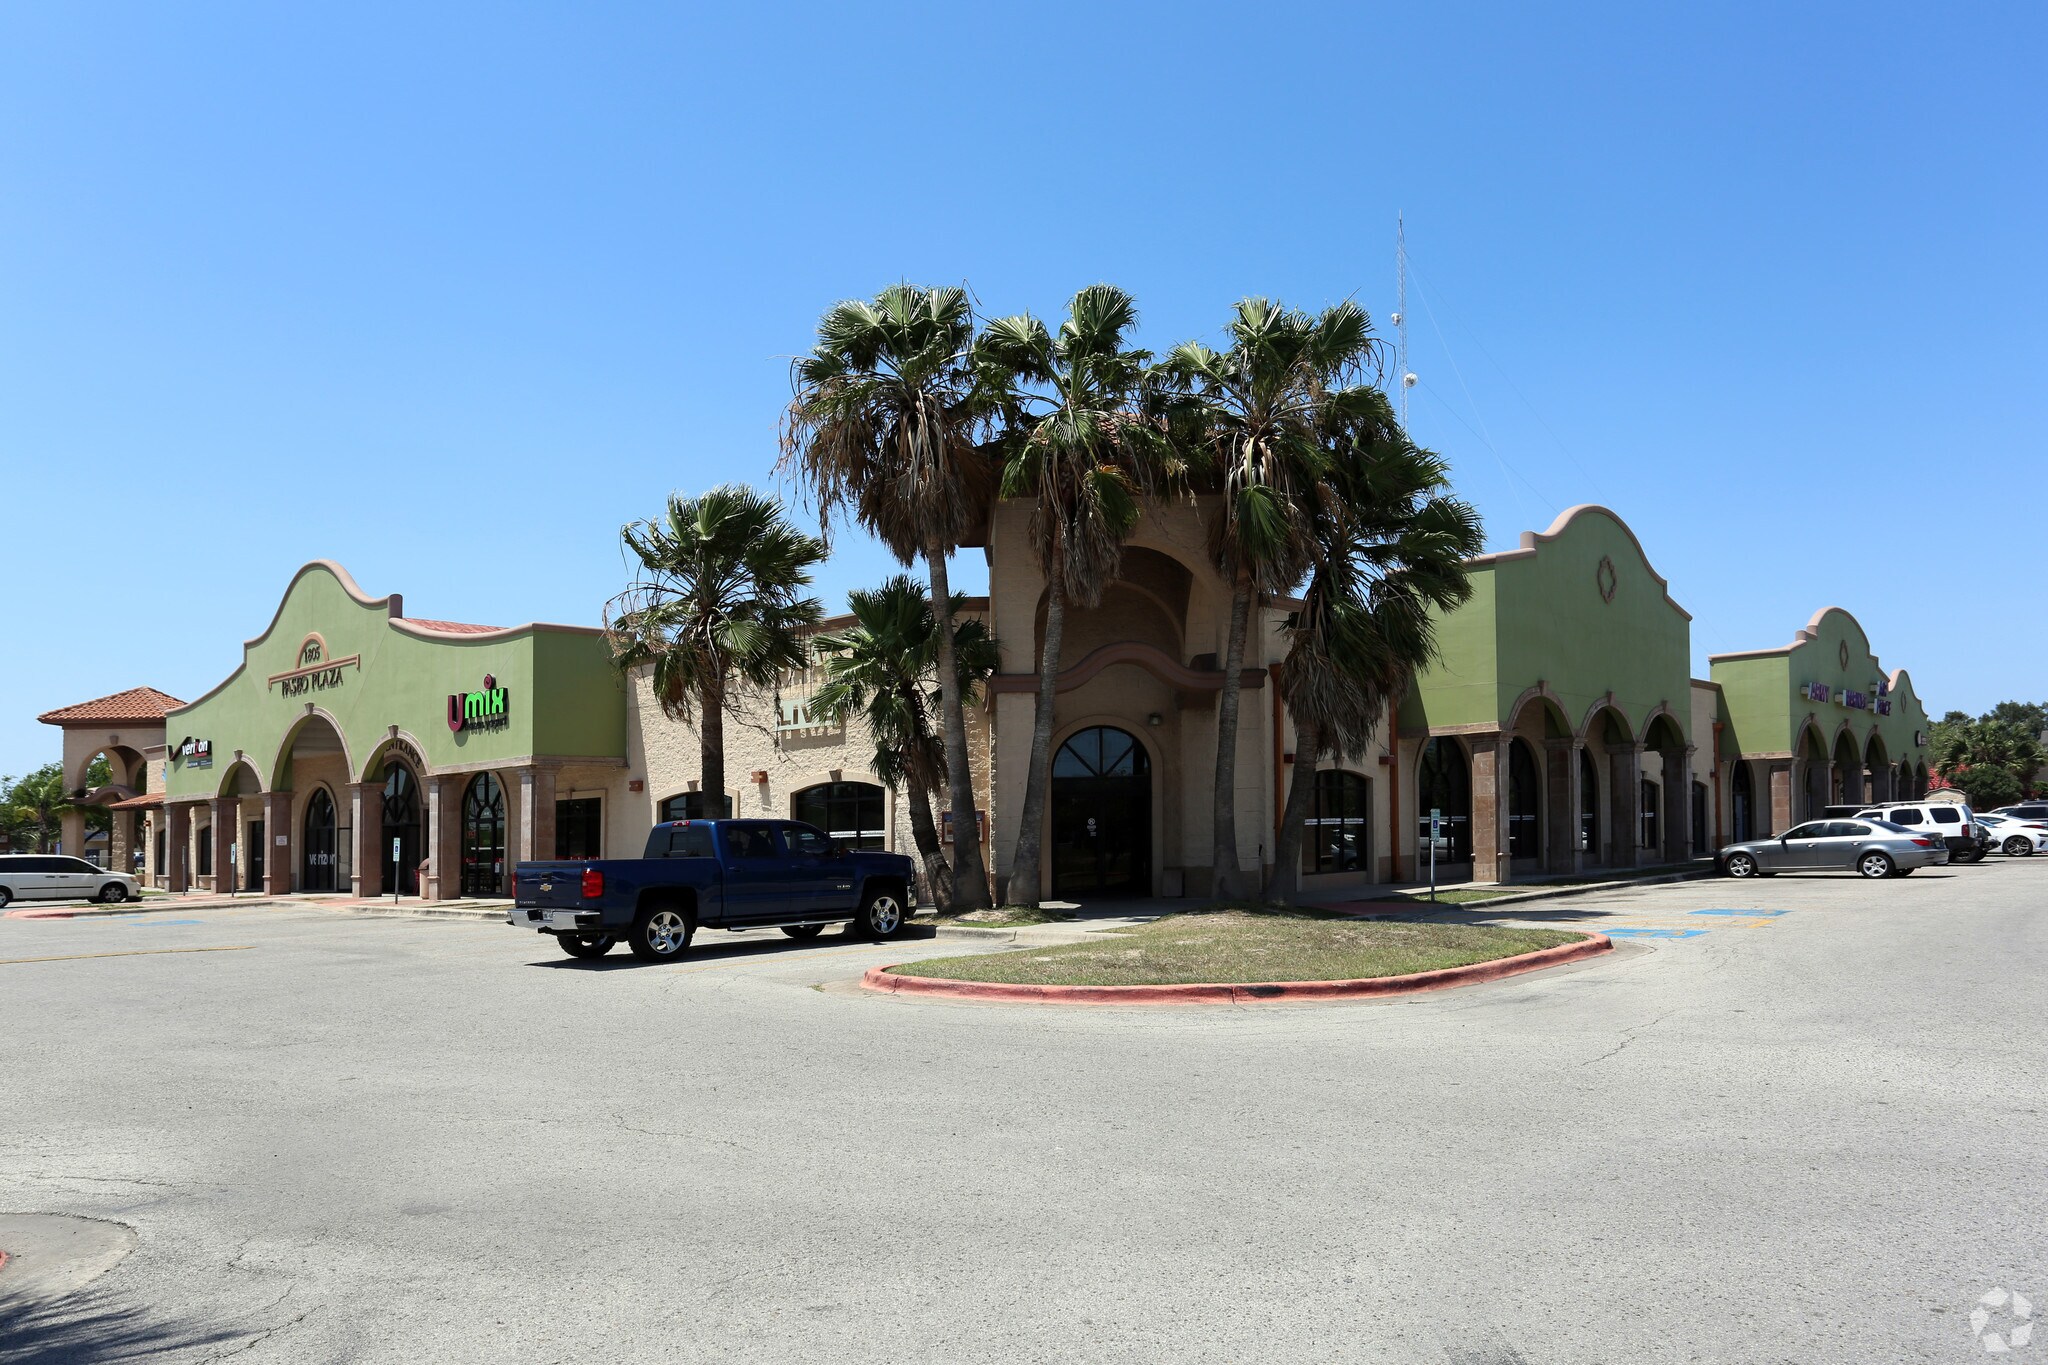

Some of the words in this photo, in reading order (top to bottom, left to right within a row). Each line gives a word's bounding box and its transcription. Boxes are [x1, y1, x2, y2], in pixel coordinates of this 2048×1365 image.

[304, 646, 320, 663] 1805
[282, 675, 308, 697] PASEO
[312, 667, 343, 690] PLAZA
[182, 739, 208, 757] verizon
